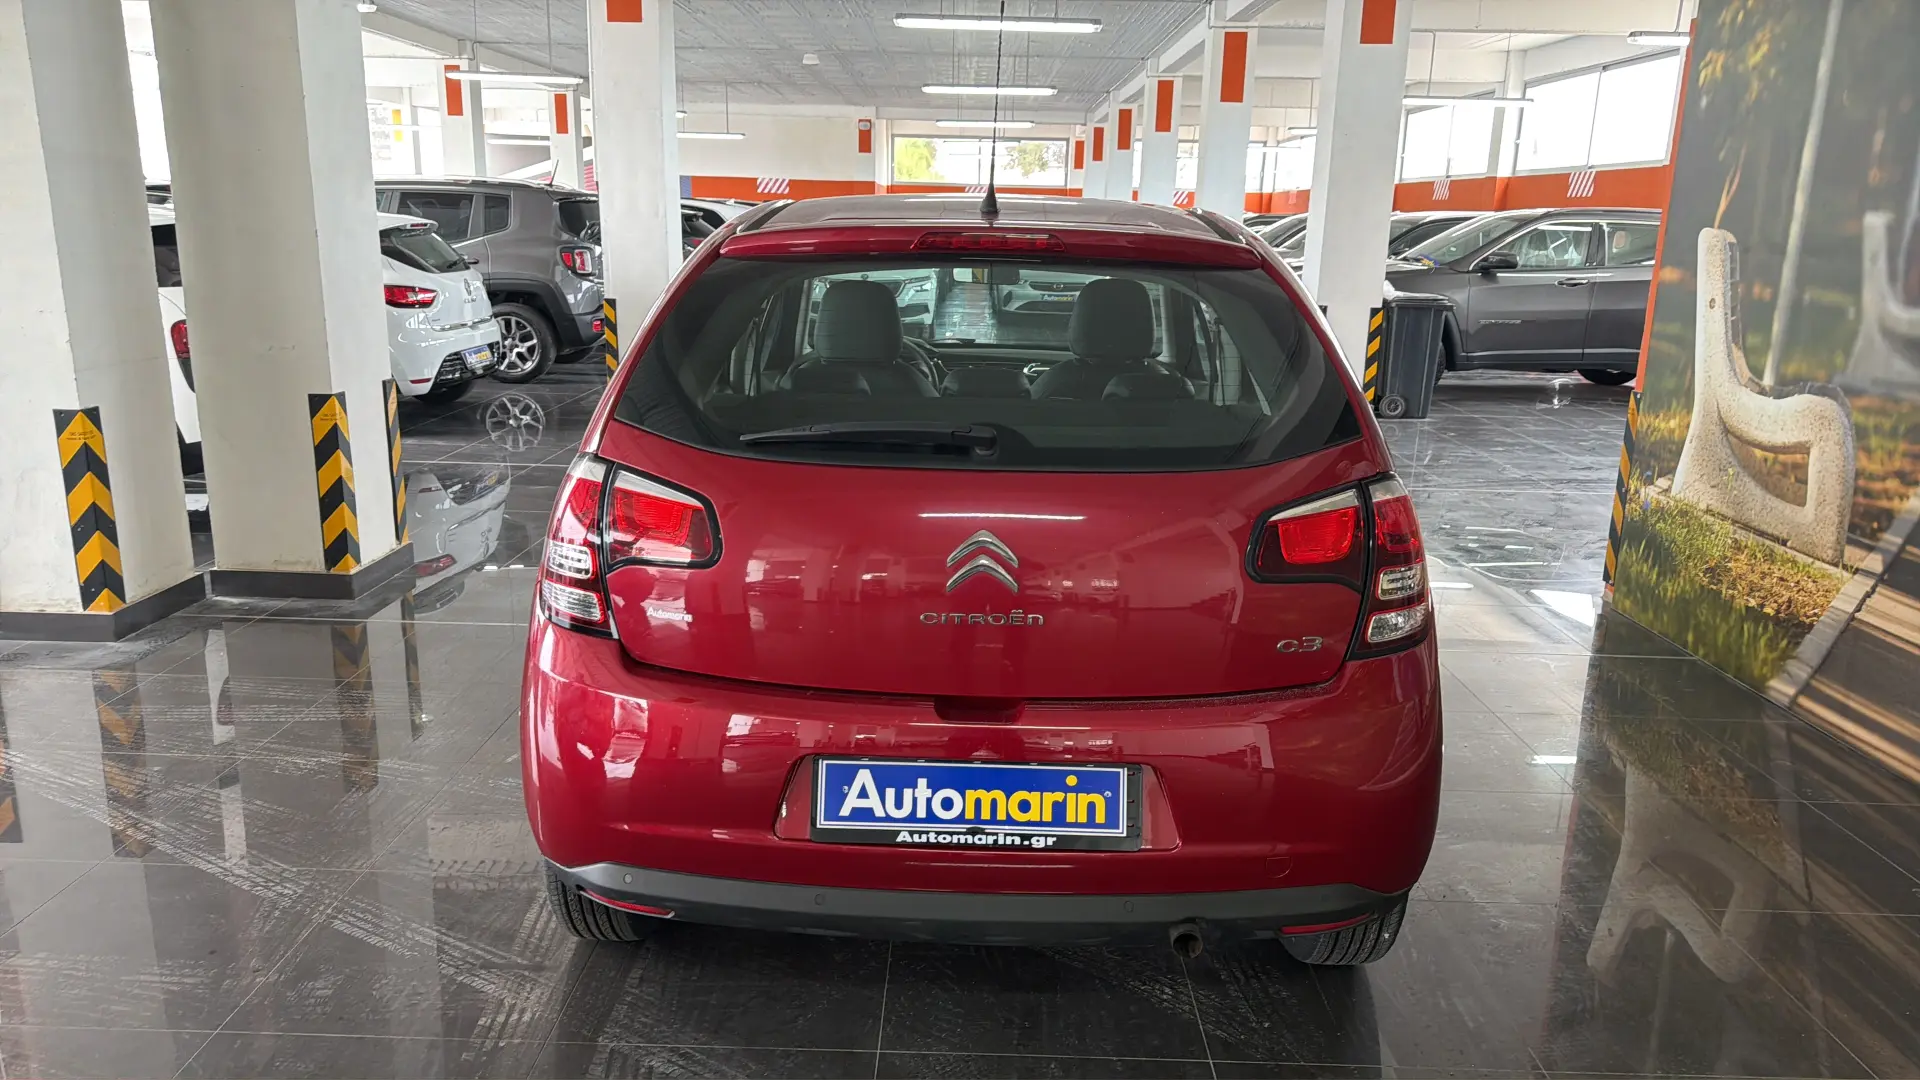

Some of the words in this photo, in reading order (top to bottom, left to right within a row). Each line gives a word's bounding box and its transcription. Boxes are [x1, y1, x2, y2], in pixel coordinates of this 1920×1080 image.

[1277, 636, 1323, 653] C3
[838, 768, 1106, 824] Automarin
[896, 830, 1057, 848] Automarin.gr
